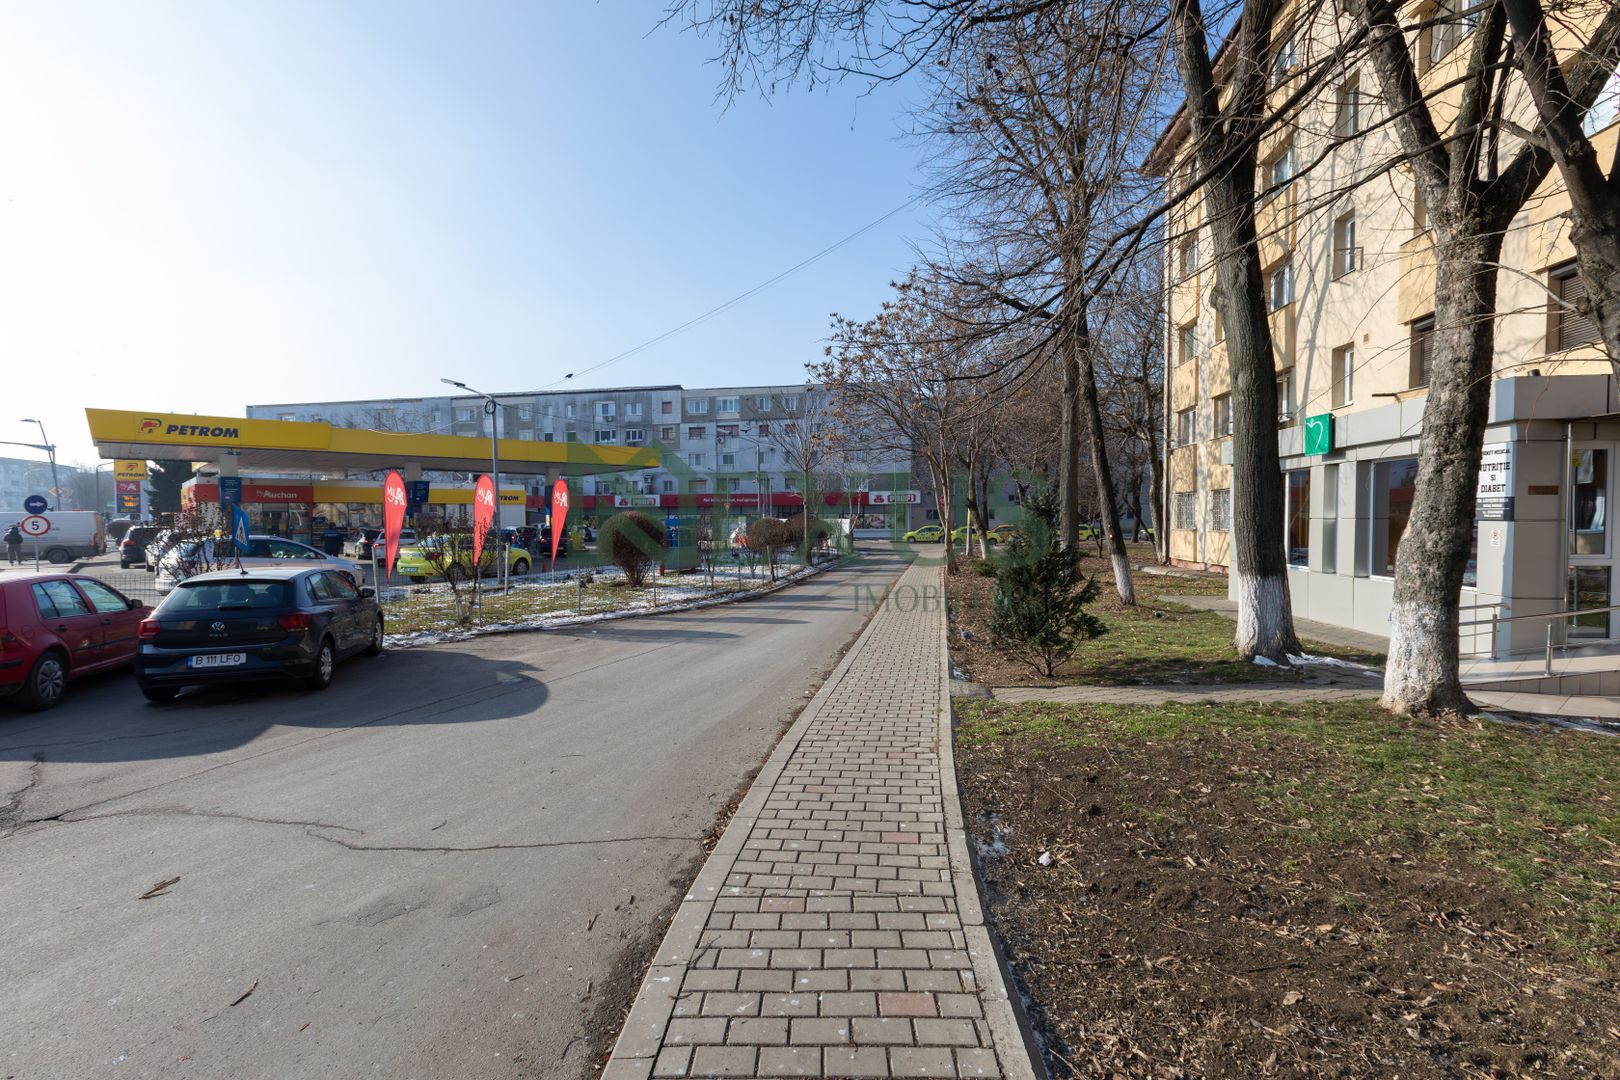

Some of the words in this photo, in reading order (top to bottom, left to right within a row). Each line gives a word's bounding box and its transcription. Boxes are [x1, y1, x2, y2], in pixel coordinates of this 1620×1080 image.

[165, 424, 239, 439] PETROM
[1480, 484, 1506, 493] DIABET
[263, 490, 297, 499] Auchan
[31, 521, 40, 531] 5
[195, 656, 203, 665] B
[206, 655, 217, 665] 111
[220, 654, 241, 664] LFO
